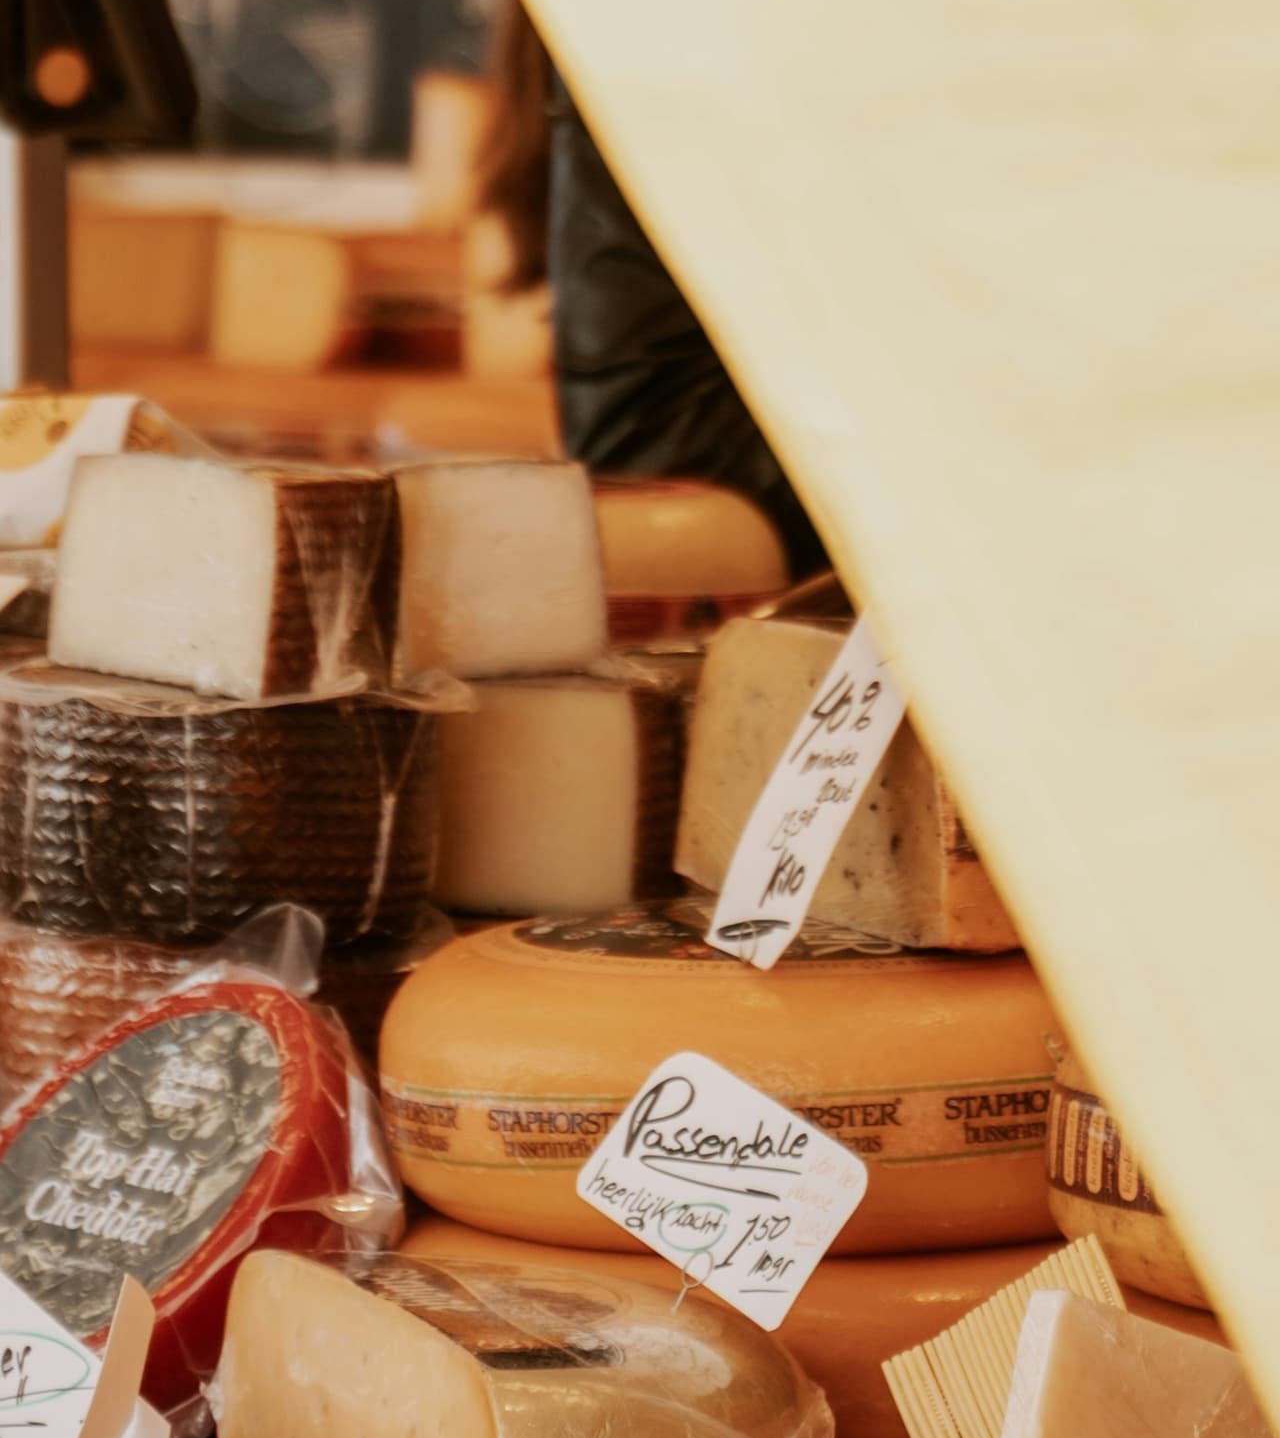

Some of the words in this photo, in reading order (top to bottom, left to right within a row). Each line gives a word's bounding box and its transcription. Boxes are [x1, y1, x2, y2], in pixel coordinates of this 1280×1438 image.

[488, 1107, 620, 1136] STAPHORST
[622, 1075, 810, 1168] Passendale
[944, 1089, 1051, 1121] STAPHO
[60, 1127, 130, 1191] Top
[126, 1145, 200, 1197] Hat
[24, 1177, 170, 1248] Cheddar
